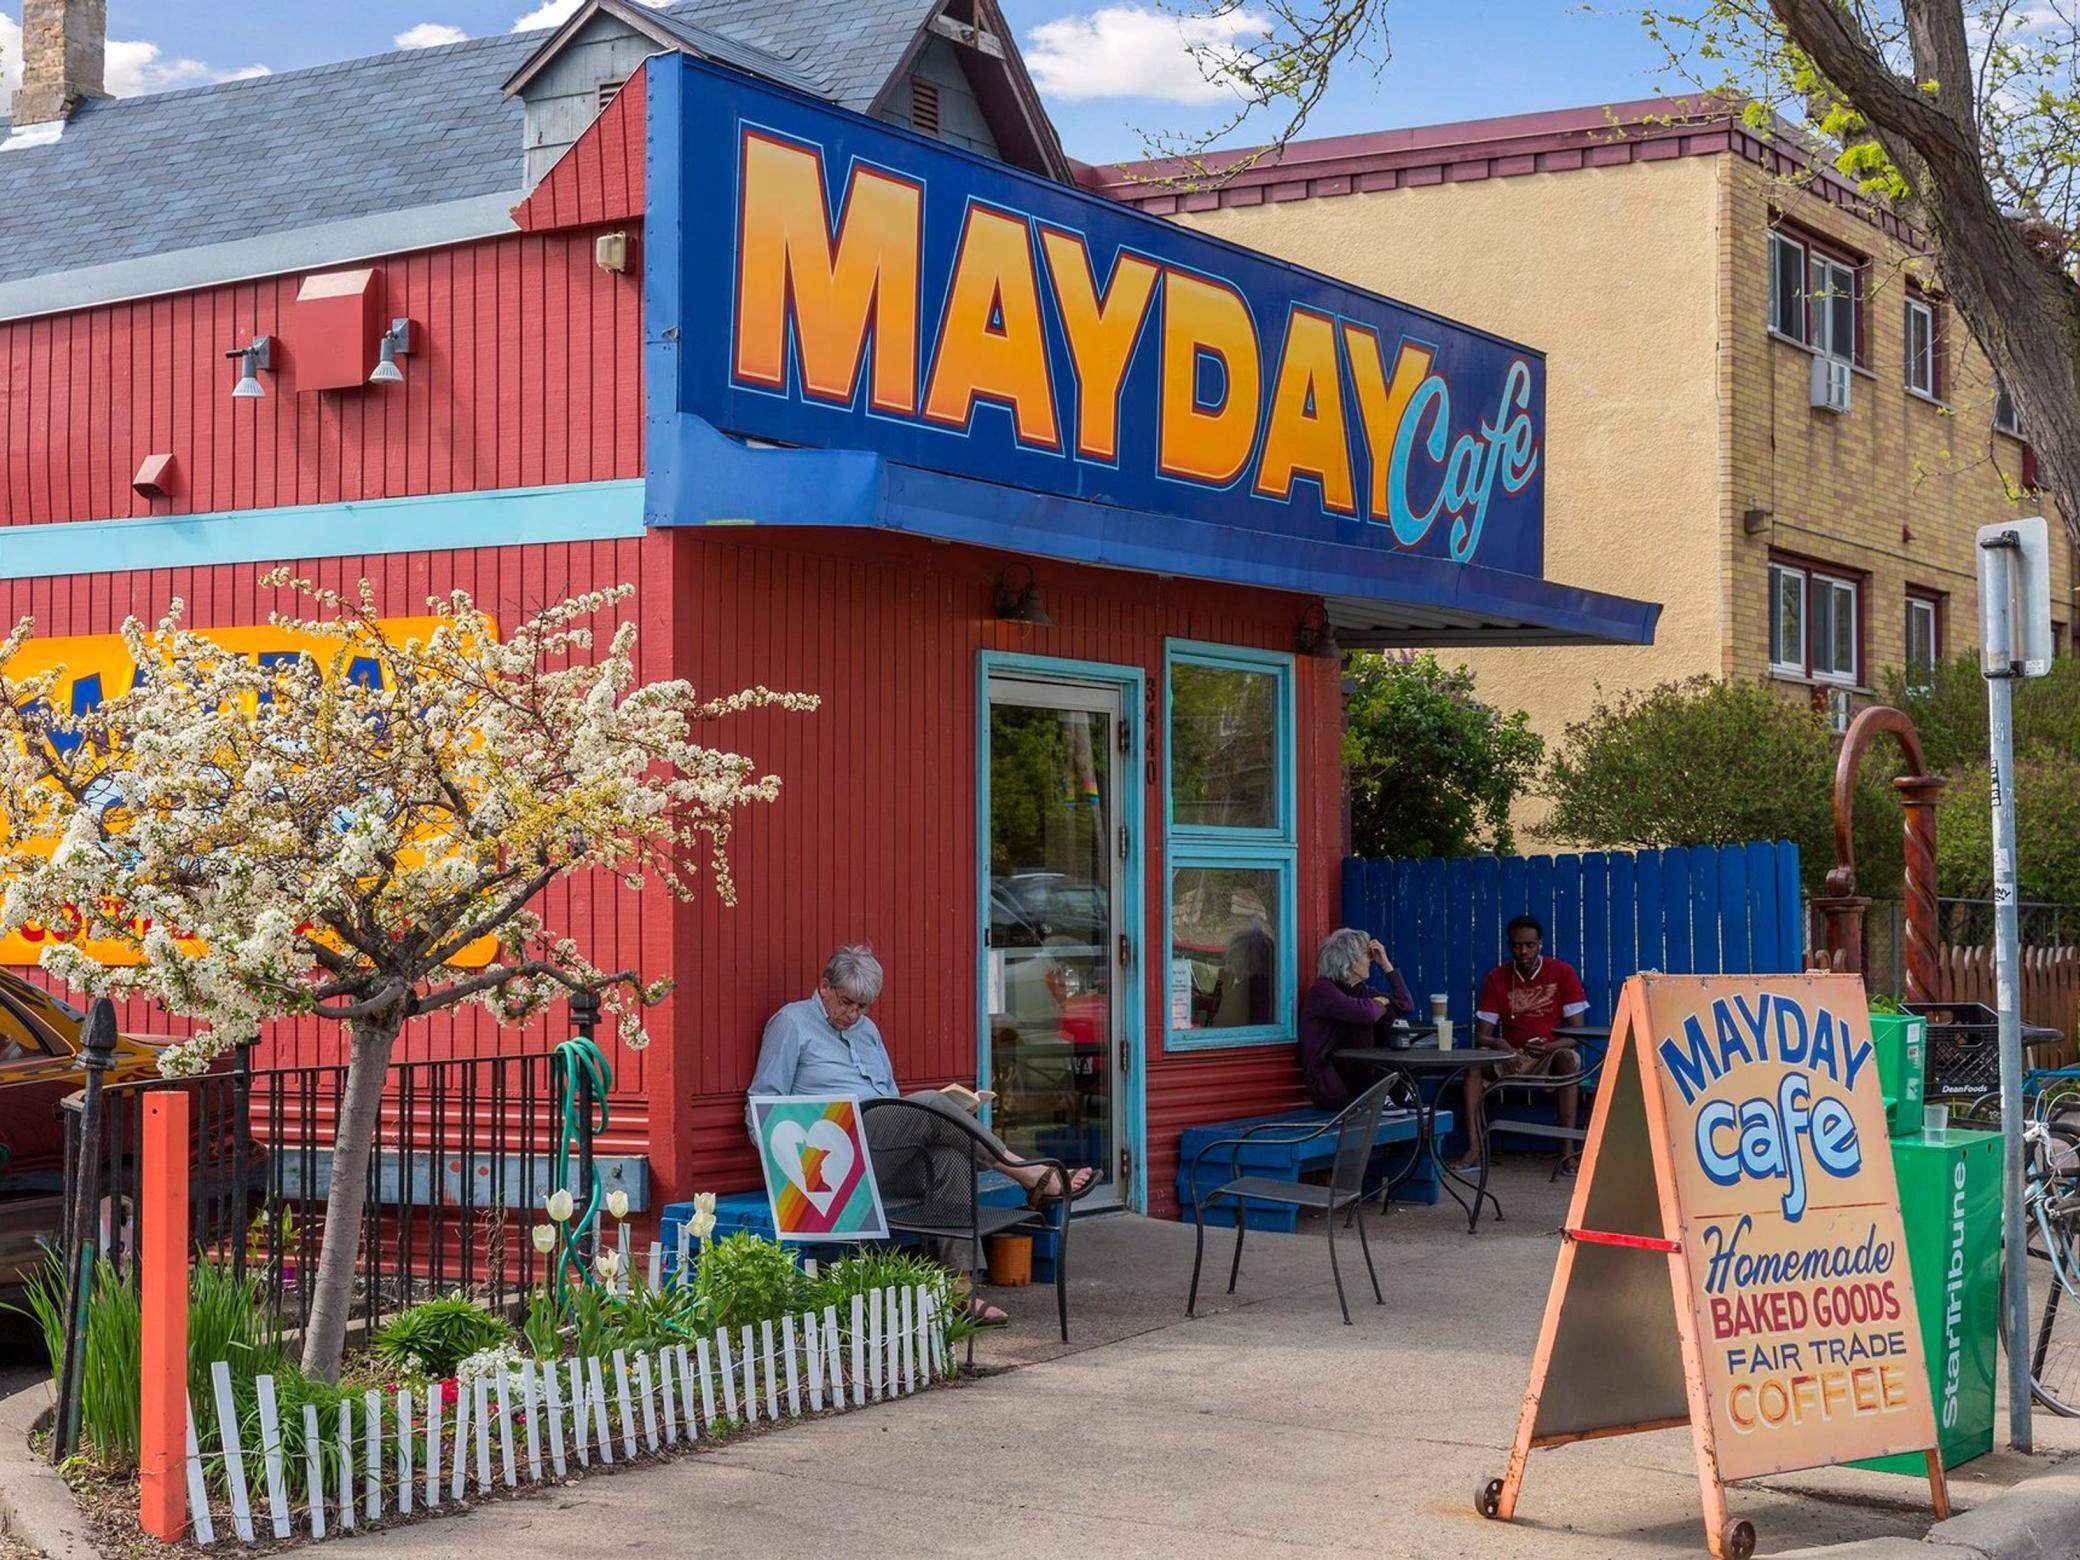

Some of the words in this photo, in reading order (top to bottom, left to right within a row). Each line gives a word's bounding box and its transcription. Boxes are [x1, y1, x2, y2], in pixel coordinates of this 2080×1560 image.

[729, 120, 1438, 527] MAYDAY
[1145, 677, 1156, 785] 3440
[1659, 994, 1873, 1105] MAYDAY
[1941, 1084, 1988, 1094] DeanFoods
[1696, 1071, 1862, 1223] cafe
[1702, 1214, 1895, 1294] Homemade
[1942, 1160, 1966, 1430] StarTribune
[1709, 1291, 1808, 1340] BAKED
[1812, 1280, 1901, 1328] GOODS
[1727, 1343, 1803, 1375] FAIR
[1808, 1331, 1907, 1366] TRADE
[1728, 1365, 1909, 1432] COFFEE
